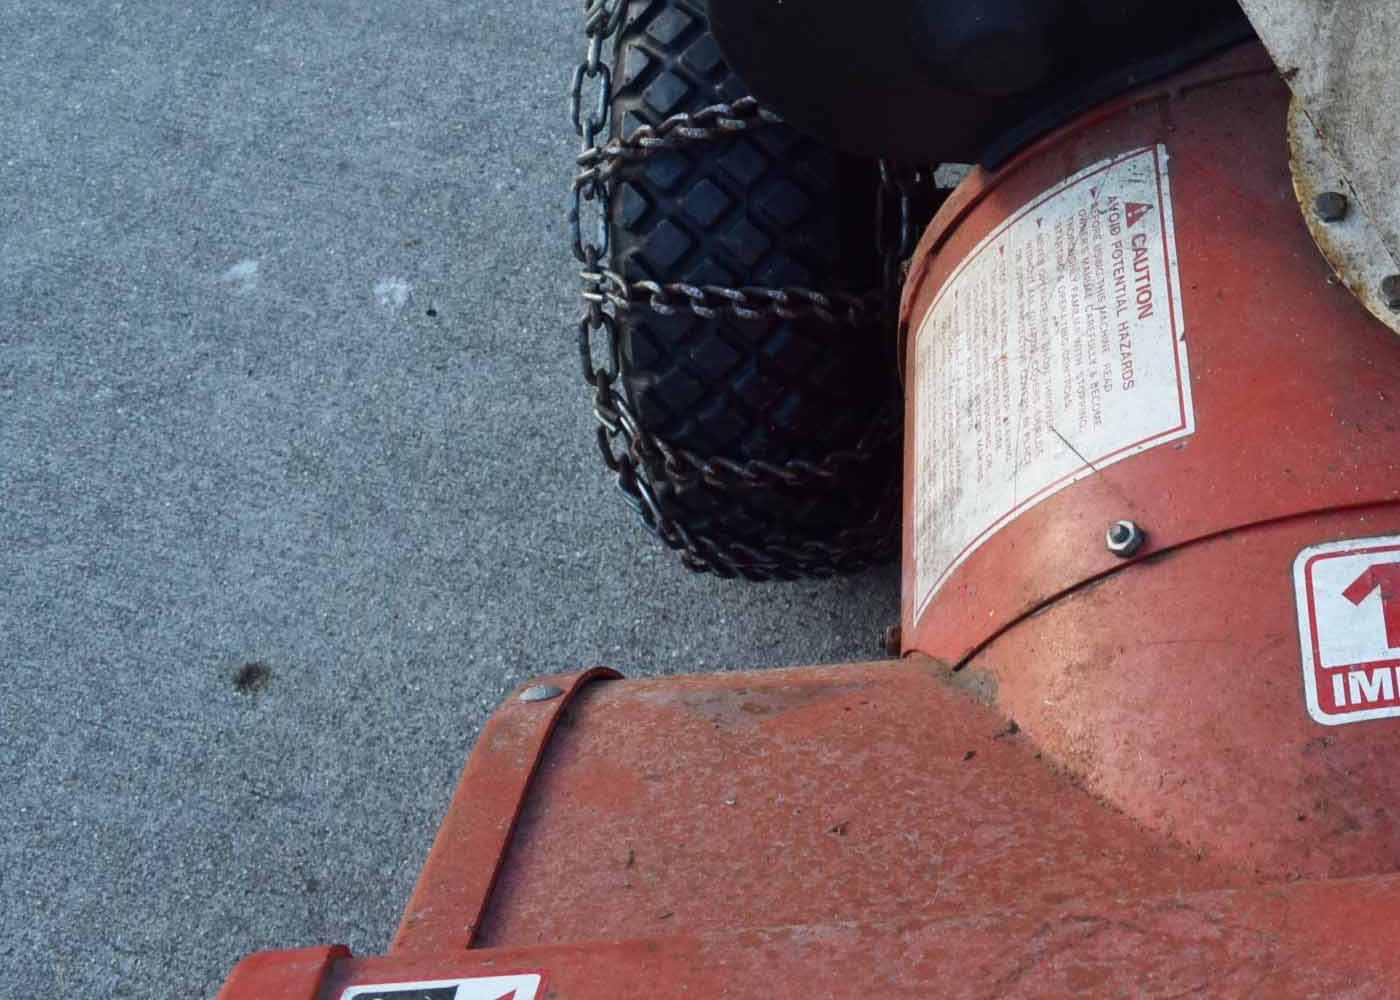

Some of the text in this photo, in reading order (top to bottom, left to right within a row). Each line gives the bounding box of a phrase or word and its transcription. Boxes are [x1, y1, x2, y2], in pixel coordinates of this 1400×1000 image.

[1095, 279, 1105, 302] THIS
[1106, 195, 1134, 390] AVOID POTENTIAL HAZARDS
[1129, 231, 1153, 321] CAUTION
